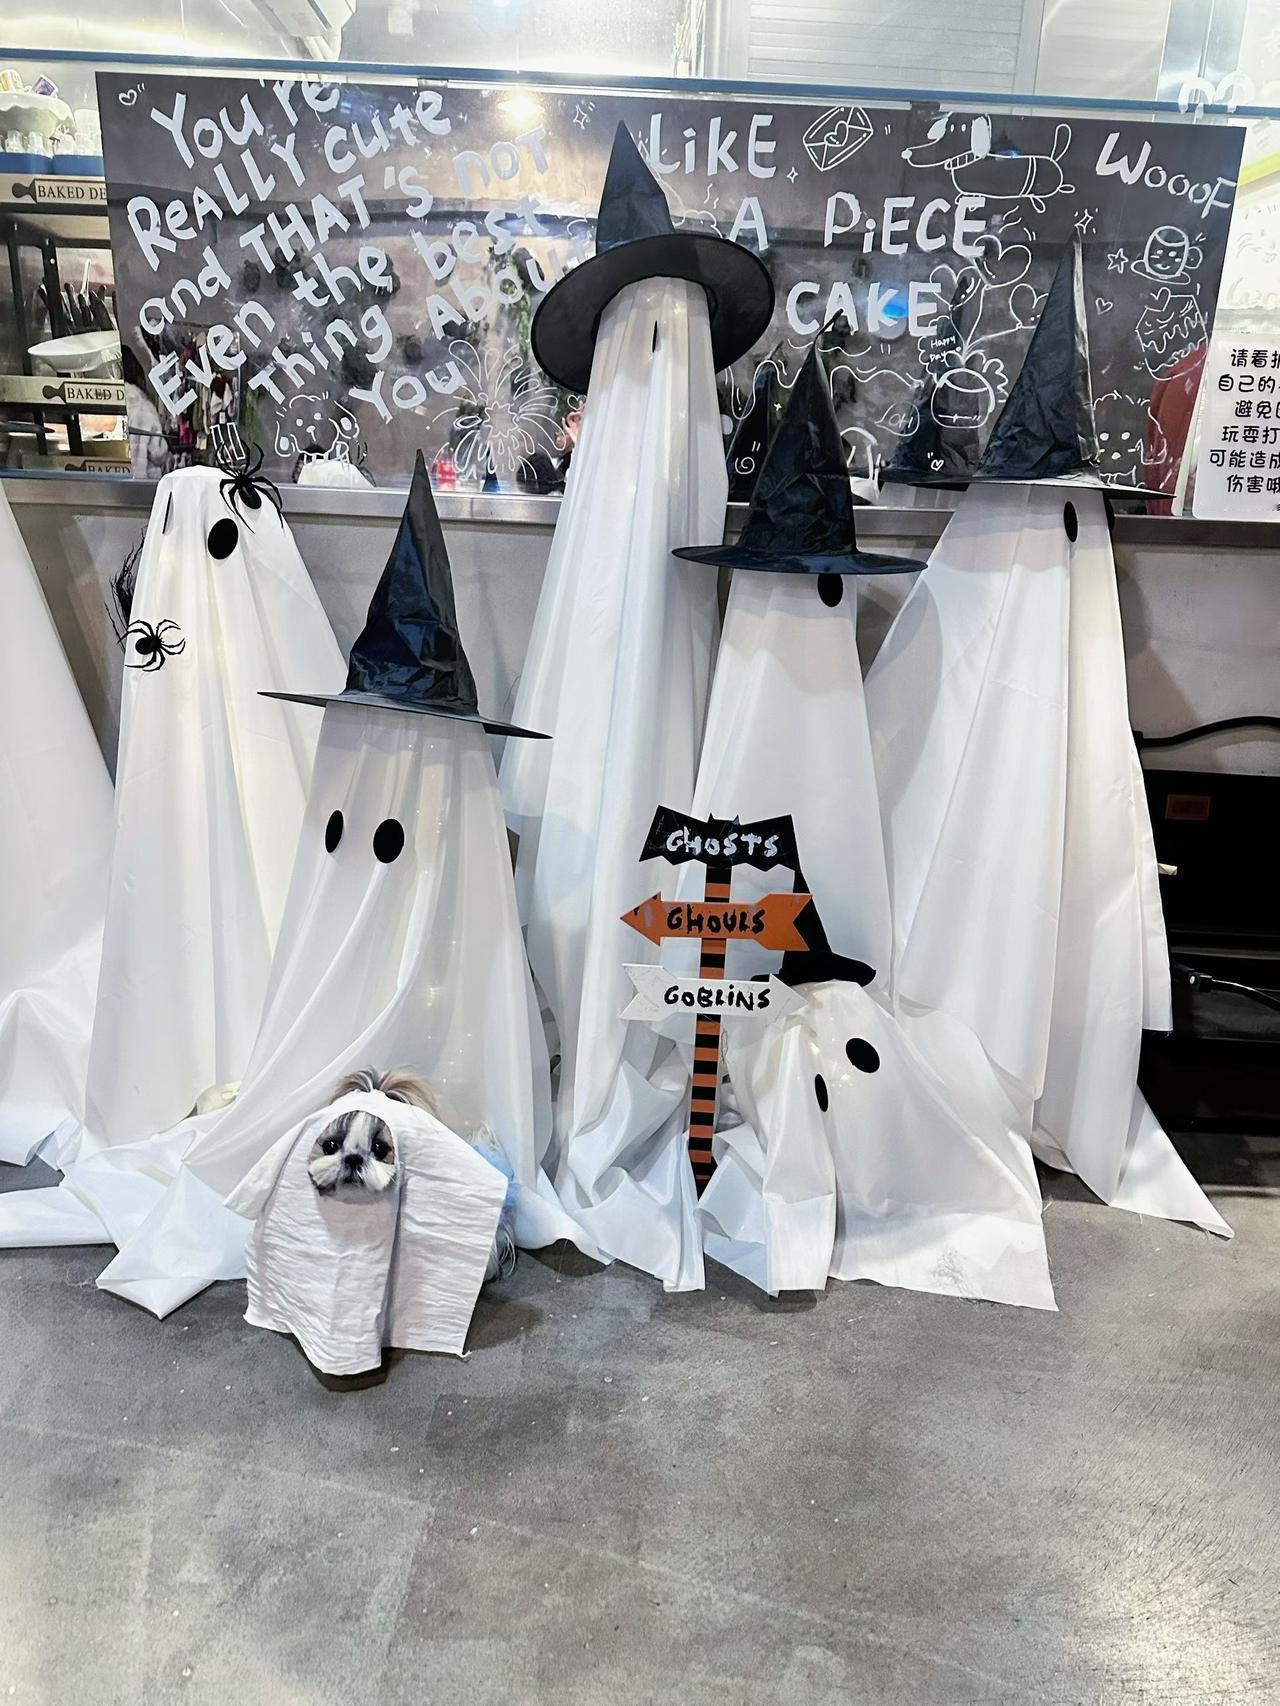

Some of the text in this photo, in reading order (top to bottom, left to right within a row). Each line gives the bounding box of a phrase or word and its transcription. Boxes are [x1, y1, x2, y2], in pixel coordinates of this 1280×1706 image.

[37, 185, 107, 200] BAKED DE
[727, 196, 769, 250] A
[139, 246, 231, 335] and
[148, 195, 549, 417] Even the best
[785, 281, 943, 336] CAKE
[248, 304, 392, 405] Thing
[67, 388, 112, 401] BAKED
[349, 361, 468, 424] You
[1218, 374, 1280, 394] 自己的
[1234, 400, 1280, 419] 避免
[665, 826, 780, 857] GHOSTS
[666, 904, 766, 934] GHOULS
